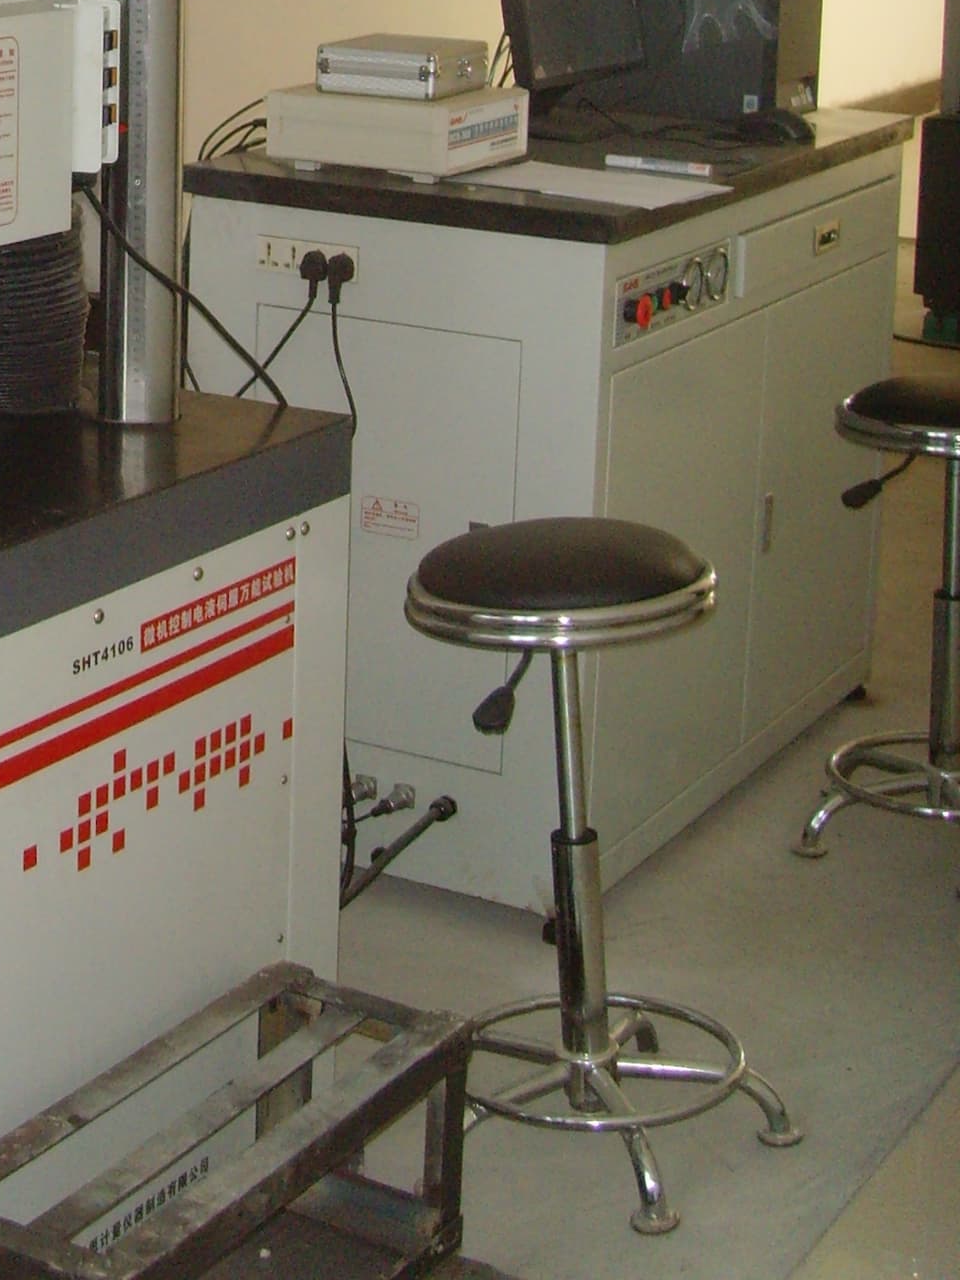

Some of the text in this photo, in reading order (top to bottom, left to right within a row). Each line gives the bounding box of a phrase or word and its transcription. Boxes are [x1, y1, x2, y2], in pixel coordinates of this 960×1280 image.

[72, 563, 294, 675] SHT4106 微机控制电液伺服万能试验机
